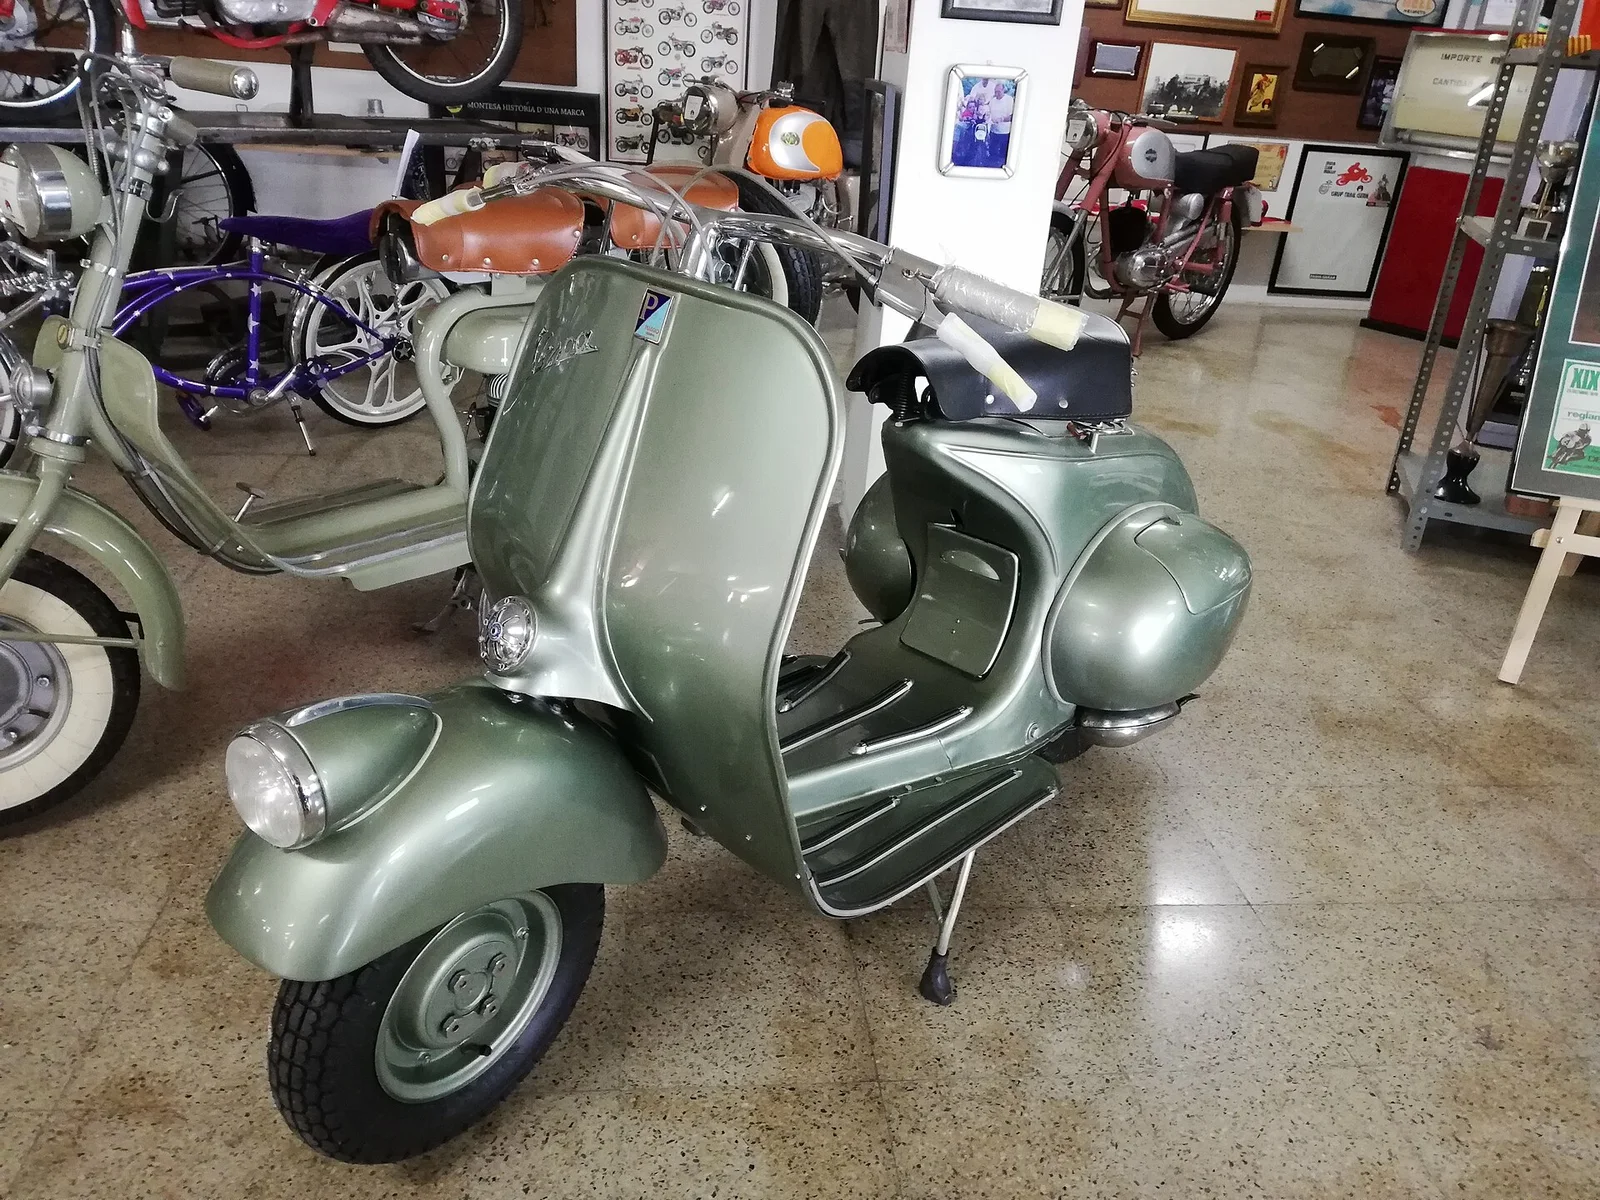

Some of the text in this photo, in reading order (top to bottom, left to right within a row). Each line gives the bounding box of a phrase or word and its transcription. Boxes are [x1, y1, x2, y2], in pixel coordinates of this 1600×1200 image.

[1440, 53, 1483, 63] IMPORTE
[467, 101, 501, 111] MONTESA
[560, 108, 585, 117] MARCA
